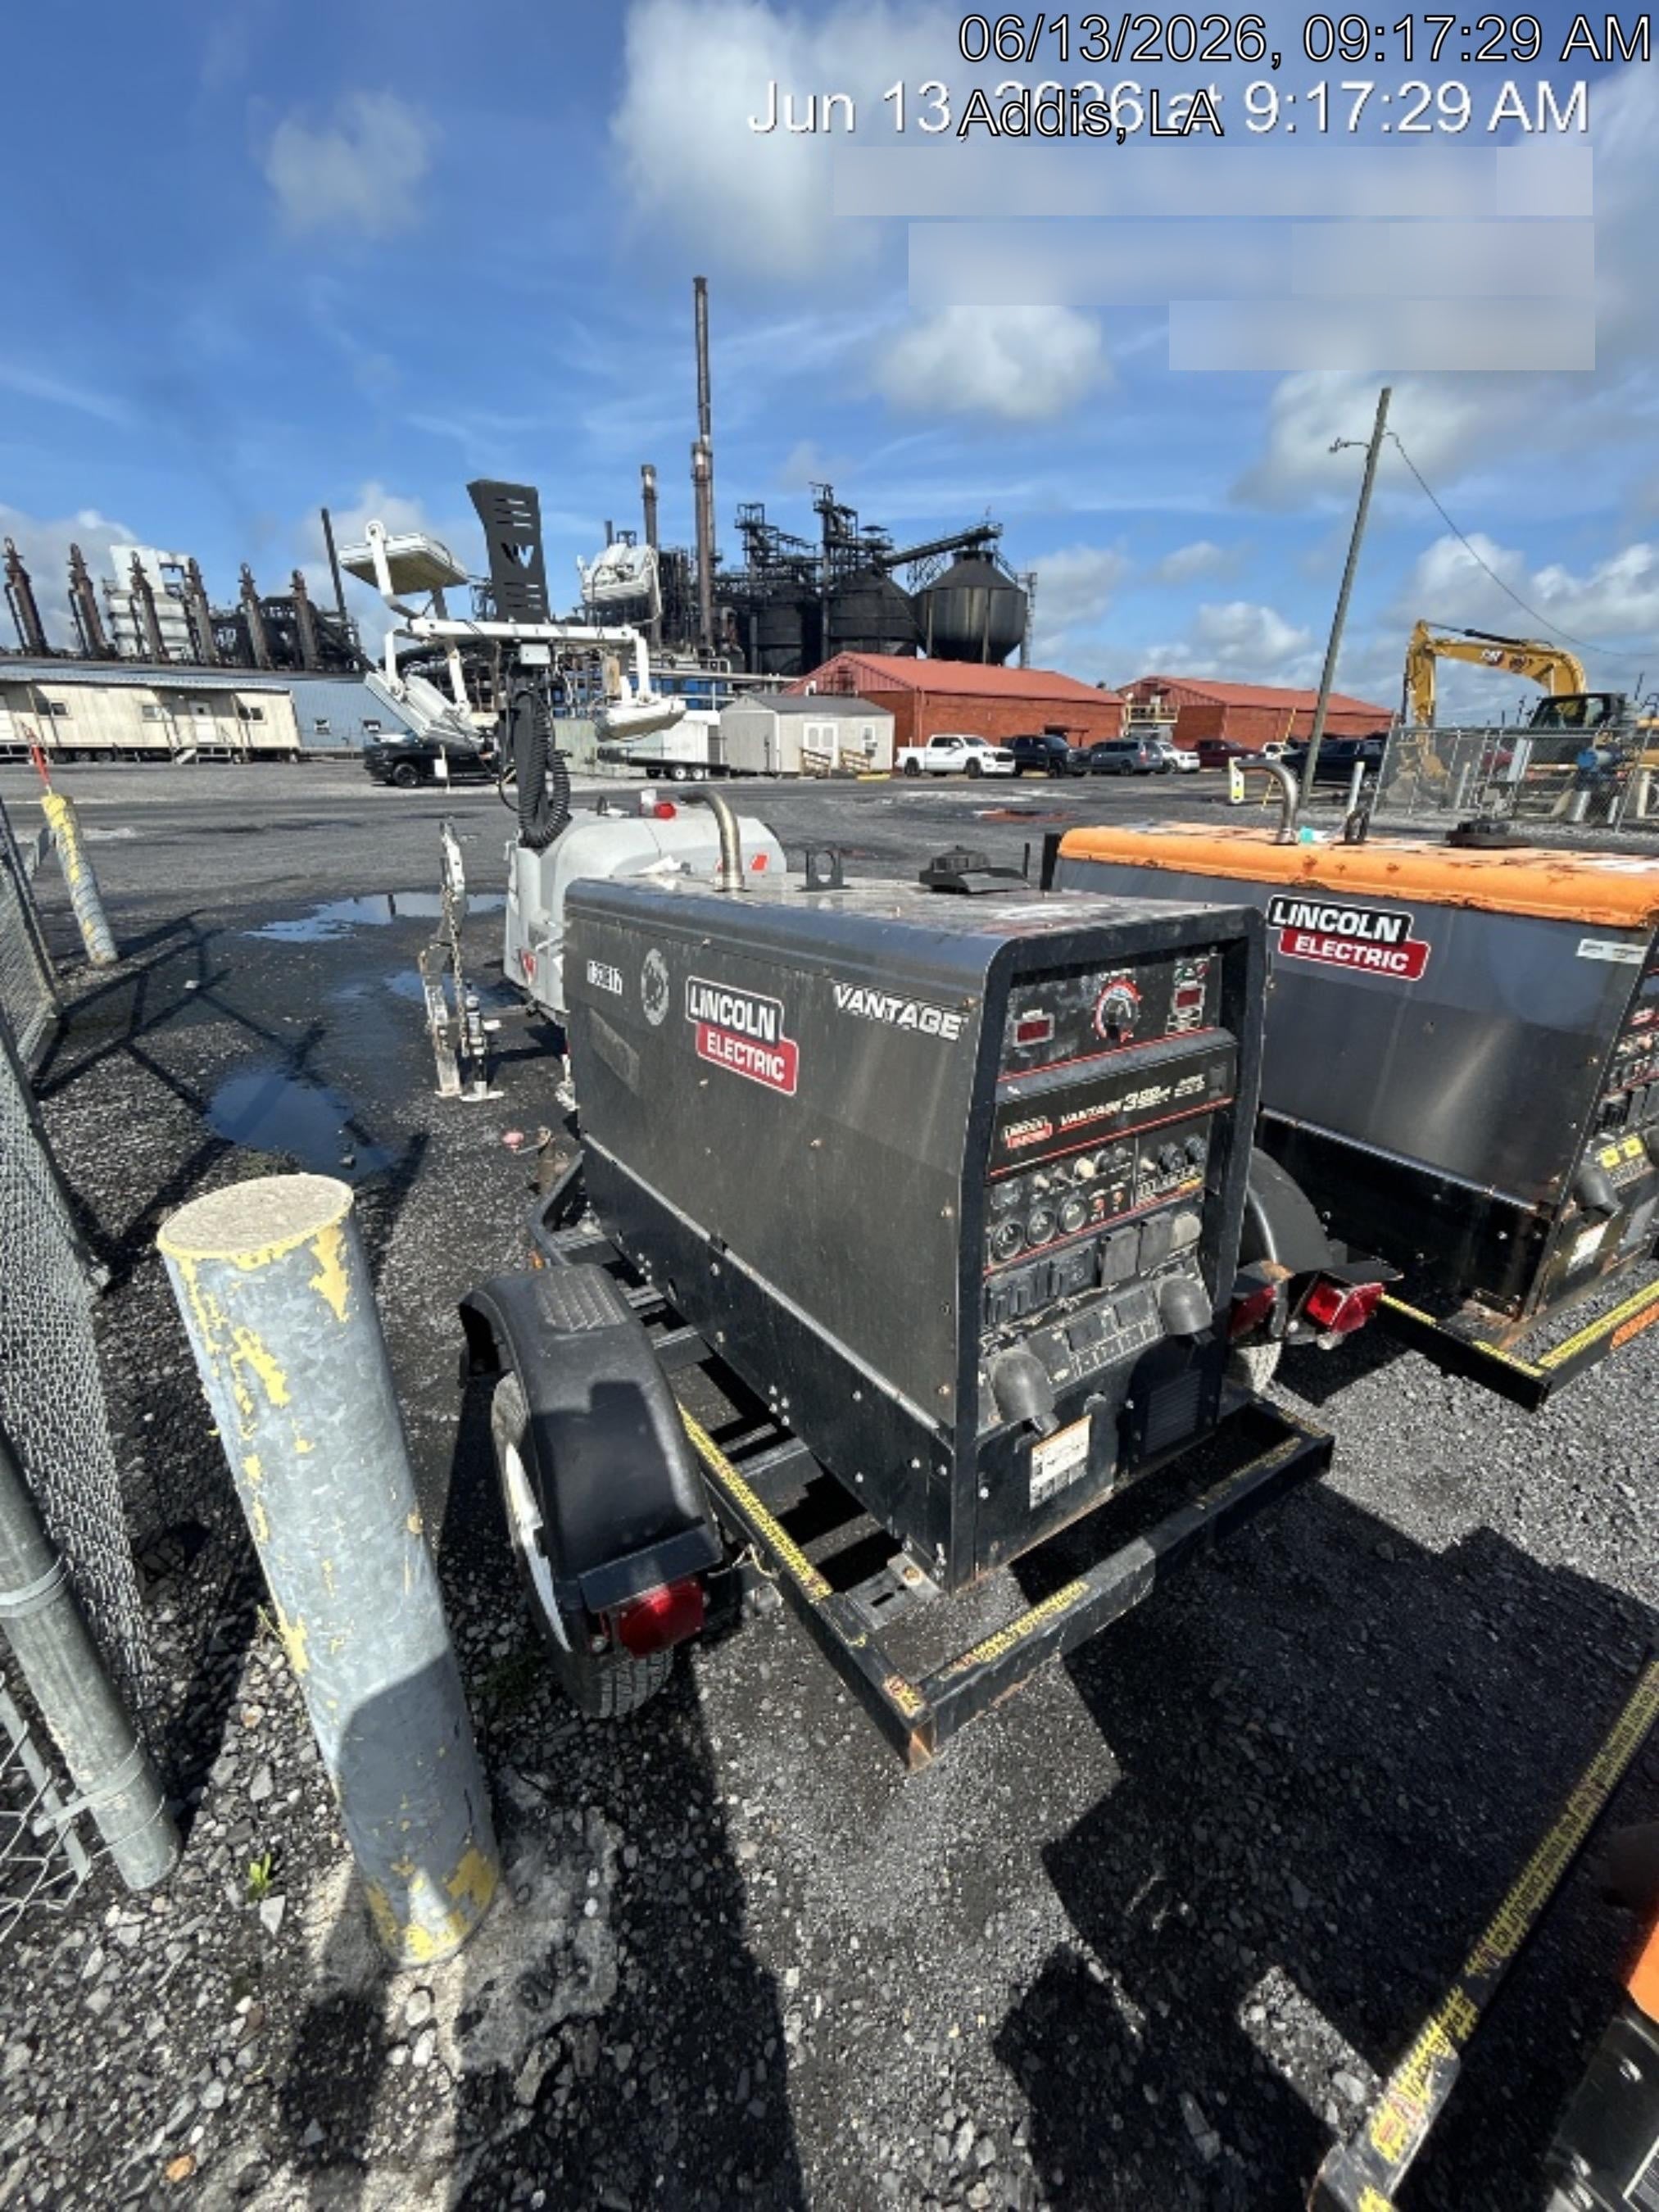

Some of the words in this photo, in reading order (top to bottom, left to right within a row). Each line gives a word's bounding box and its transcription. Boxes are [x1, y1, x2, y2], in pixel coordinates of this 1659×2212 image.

[1272, 900, 1403, 942] LINCOLN
[1294, 936, 1410, 972] ELECTRIC
[689, 984, 776, 1043] LINCOLN
[833, 983, 963, 1041] VANTAGE
[707, 1031, 786, 1082] ELECTRIC
